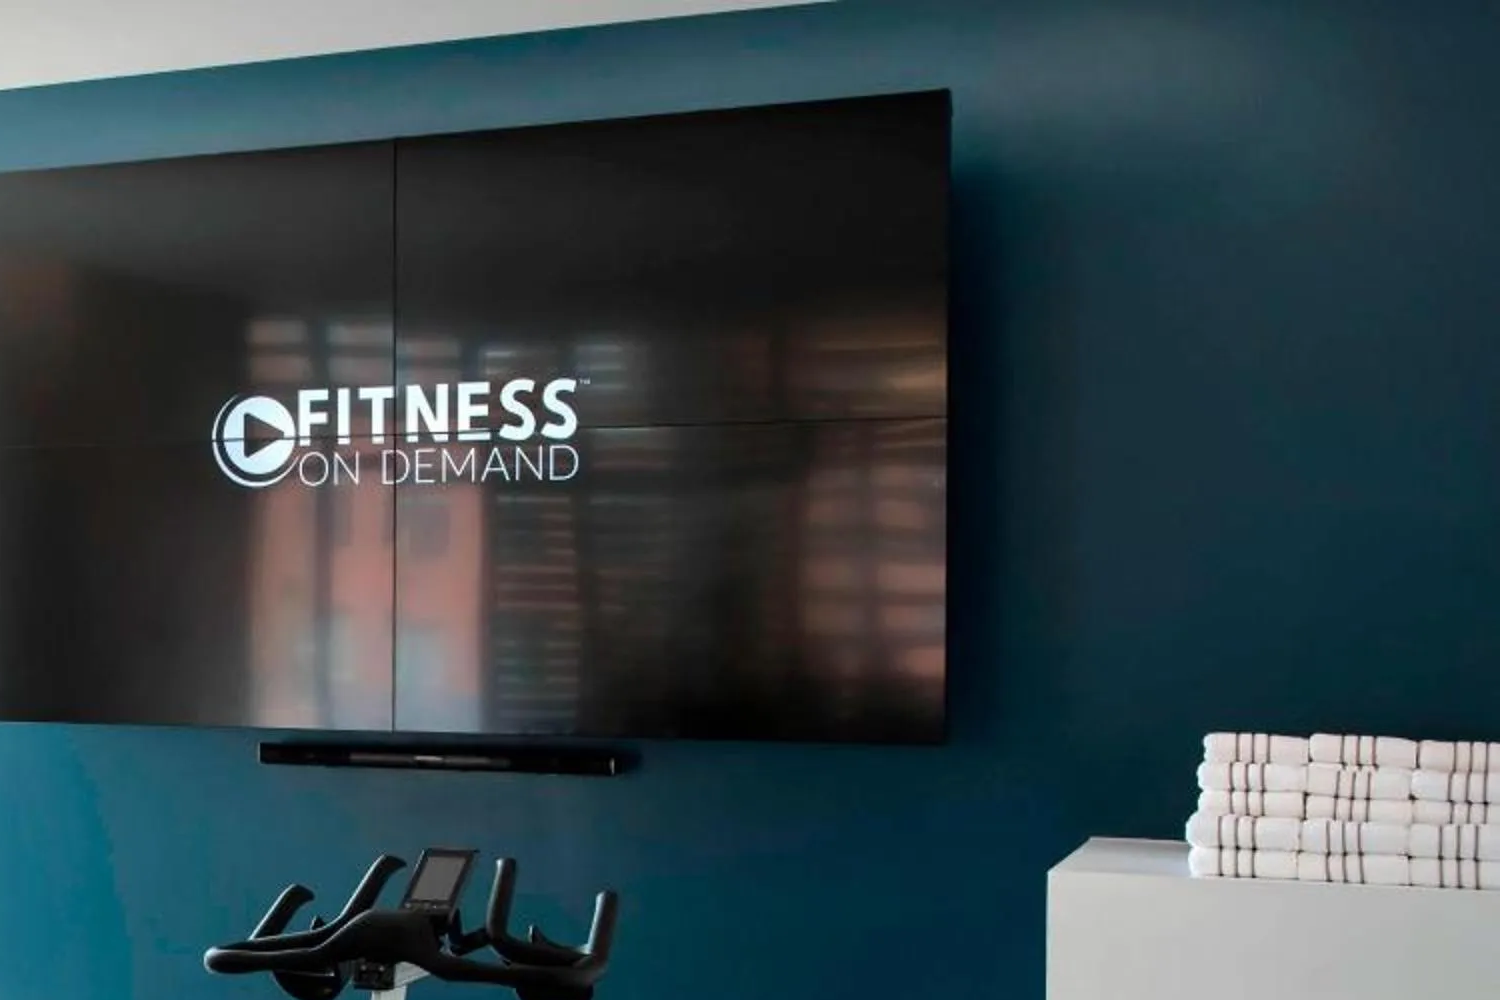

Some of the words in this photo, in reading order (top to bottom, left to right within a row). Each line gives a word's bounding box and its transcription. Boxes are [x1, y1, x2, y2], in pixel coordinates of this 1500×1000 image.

[297, 378, 578, 446] FITNESS
[299, 450, 360, 487] ON
[381, 443, 580, 487] DEMAND
